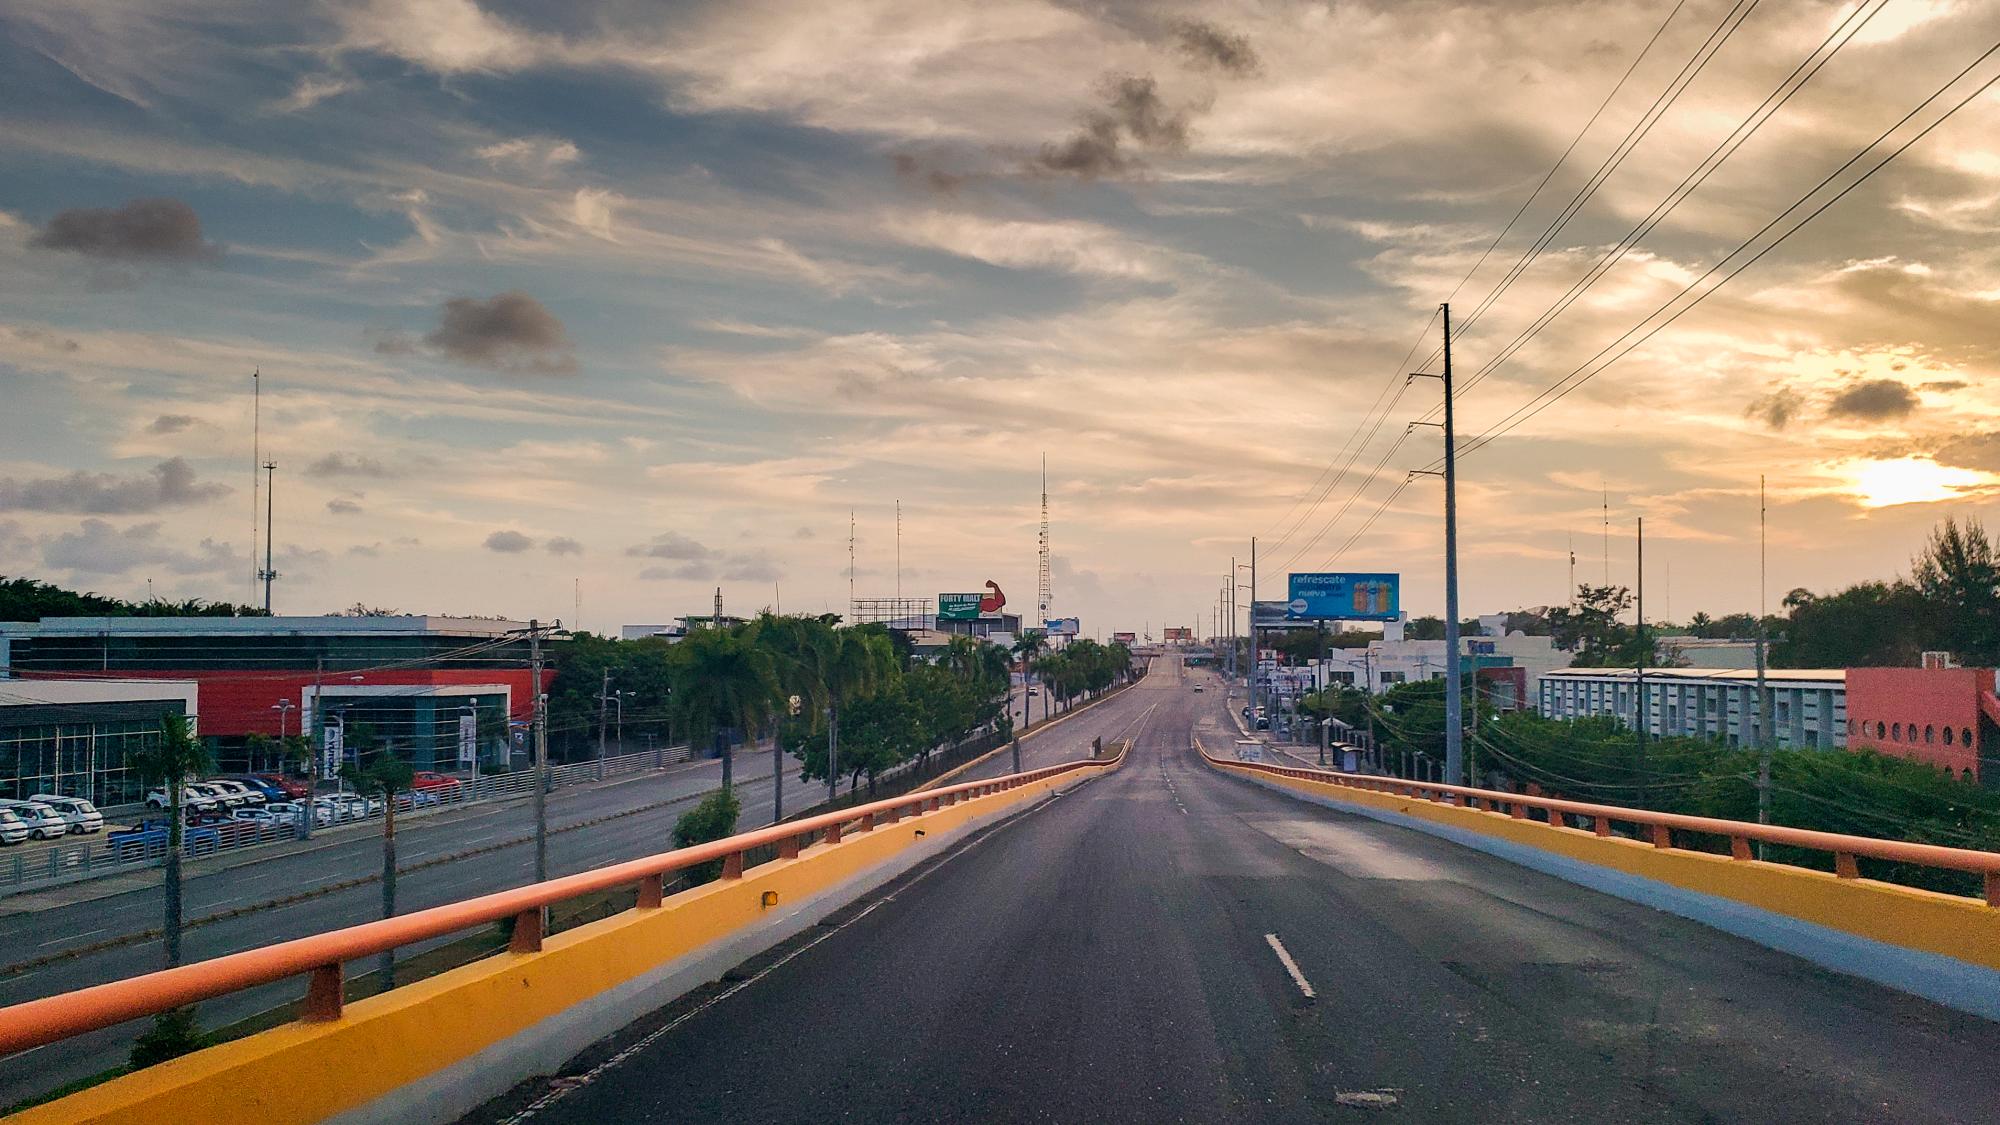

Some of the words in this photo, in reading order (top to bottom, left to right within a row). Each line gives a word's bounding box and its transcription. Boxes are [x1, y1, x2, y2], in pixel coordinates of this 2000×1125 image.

[1293, 574, 1346, 584] refrescate
[940, 594, 961, 603] FORTY
[963, 594, 981, 603] MALT
